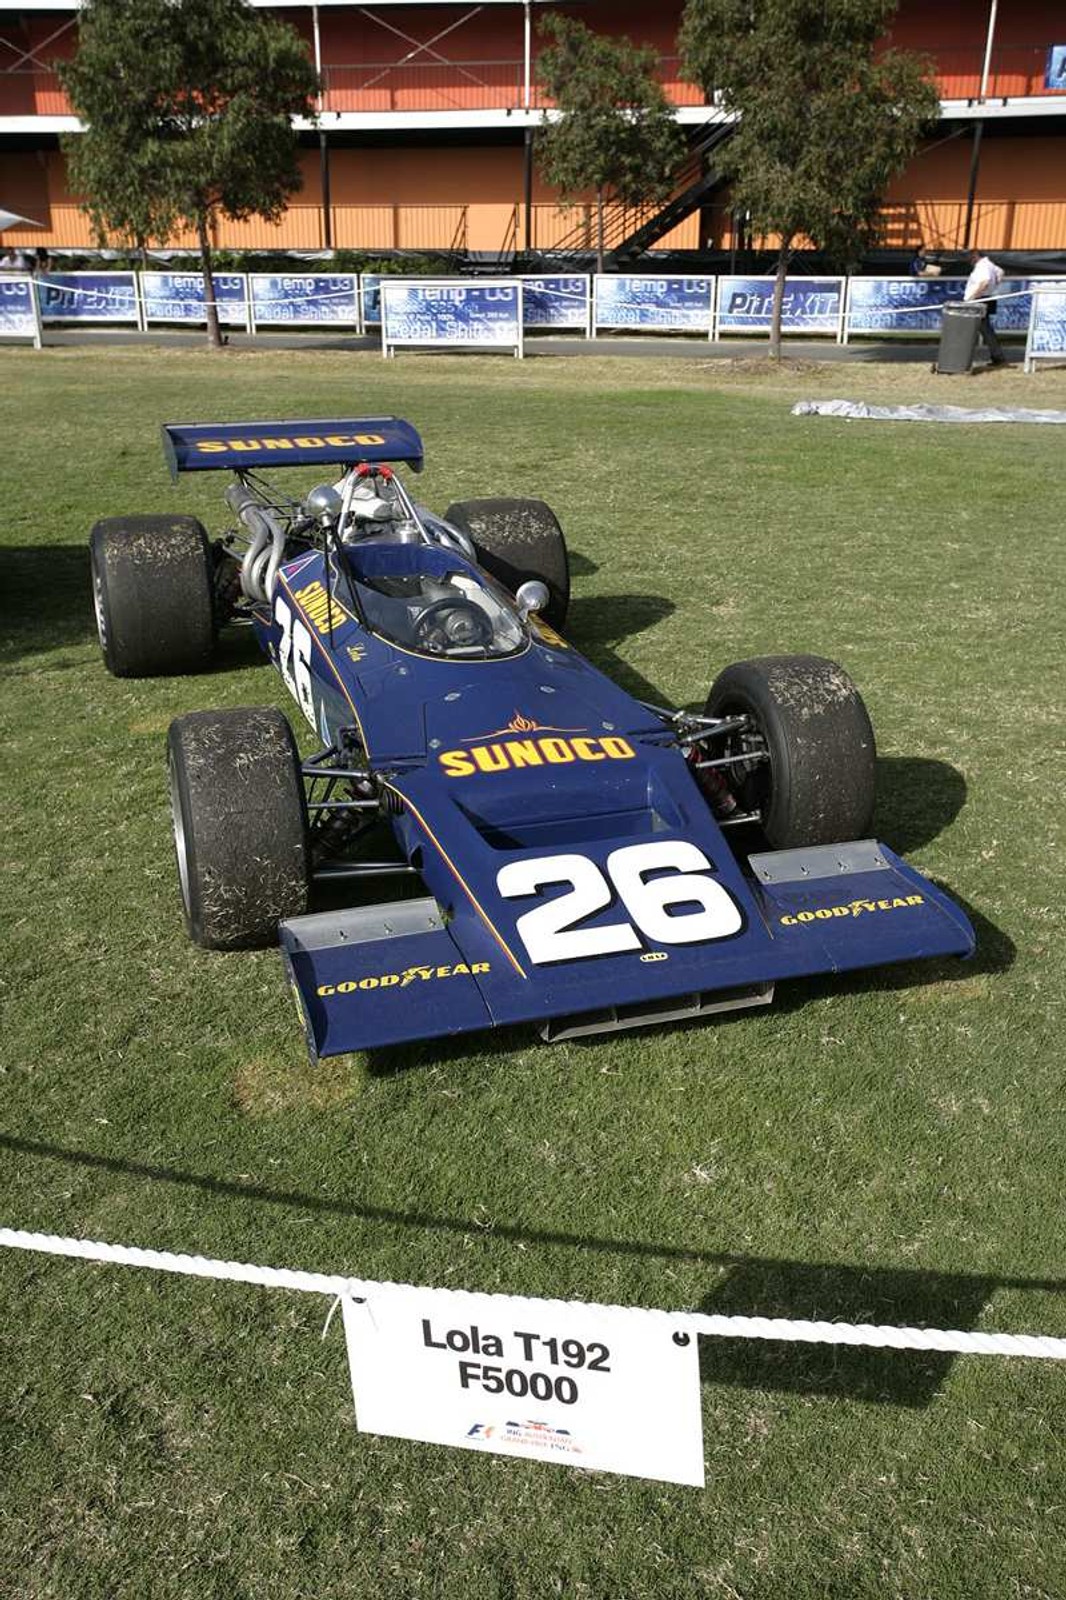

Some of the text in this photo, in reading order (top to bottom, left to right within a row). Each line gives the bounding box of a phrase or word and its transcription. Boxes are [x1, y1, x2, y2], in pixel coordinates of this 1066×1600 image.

[196, 434, 385, 453] SUNOCO
[438, 737, 636, 778] SUNOCO
[496, 840, 743, 965] 26
[421, 1318, 612, 1373] Lola T192
[458, 1360, 579, 1405] F5000
